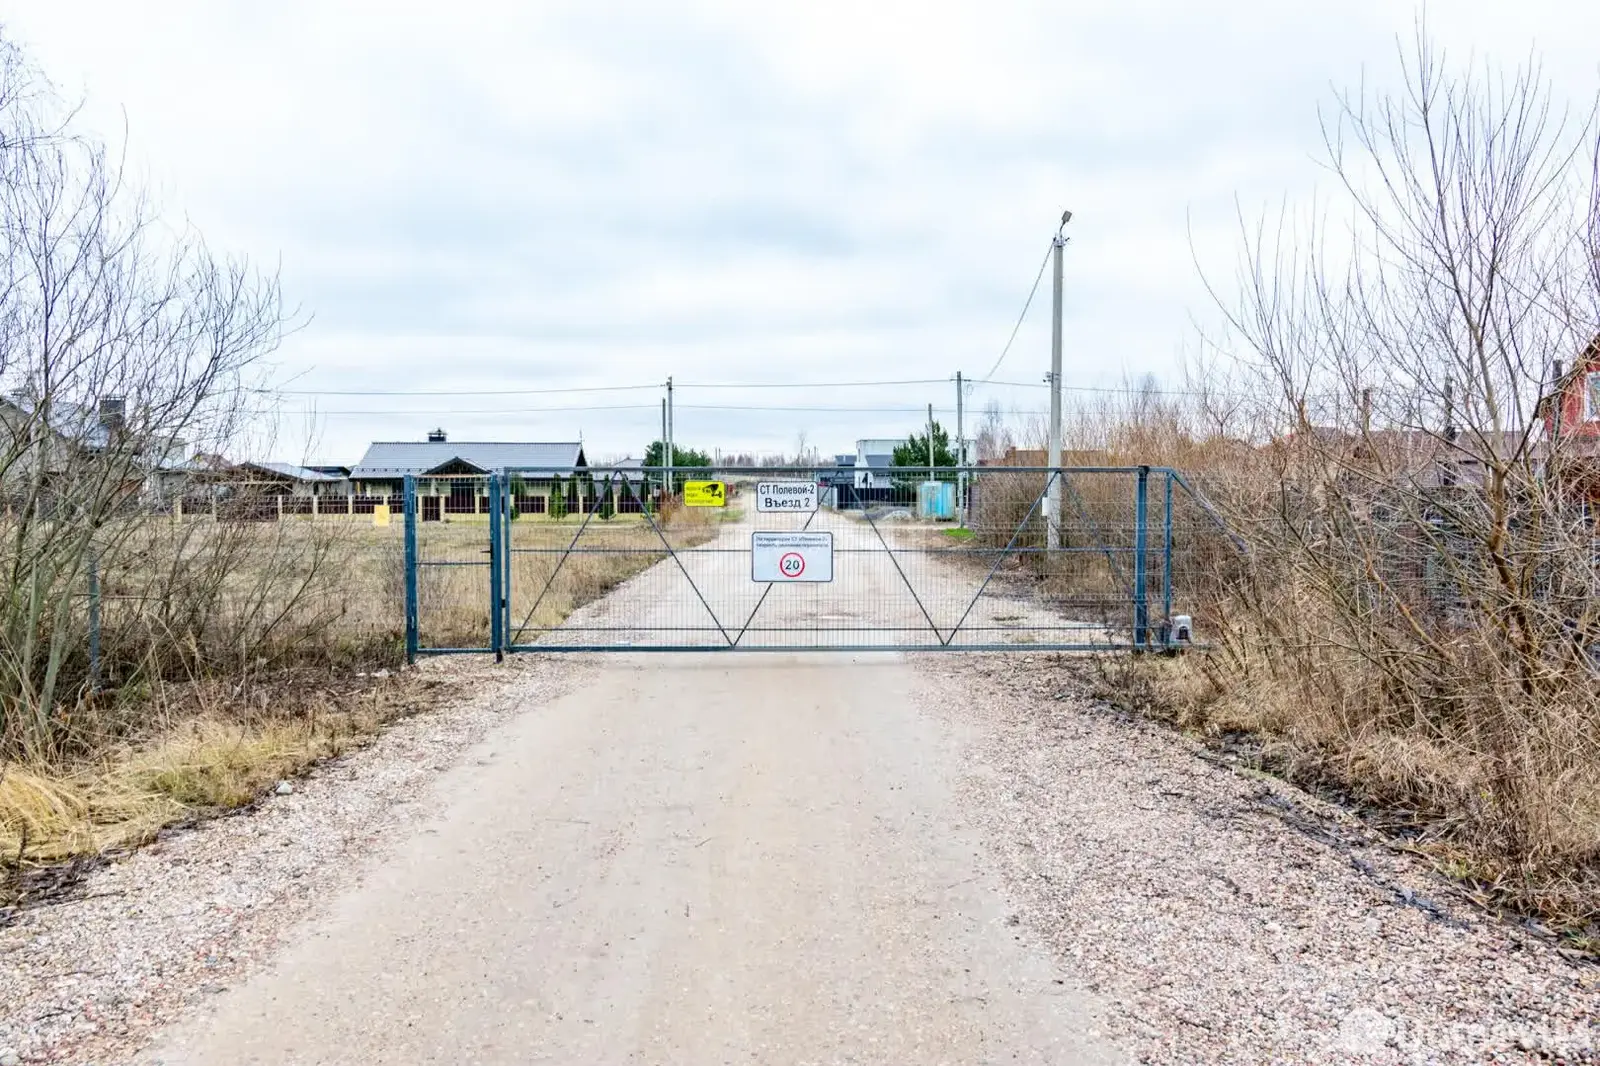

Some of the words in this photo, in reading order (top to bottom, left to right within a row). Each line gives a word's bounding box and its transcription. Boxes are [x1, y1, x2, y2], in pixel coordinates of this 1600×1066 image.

[760, 484, 770, 494] СТ
[772, 484, 814, 494] Полевой-2
[765, 498, 802, 508] Въезд
[804, 498, 810, 508] 2
[785, 560, 800, 570] 20
